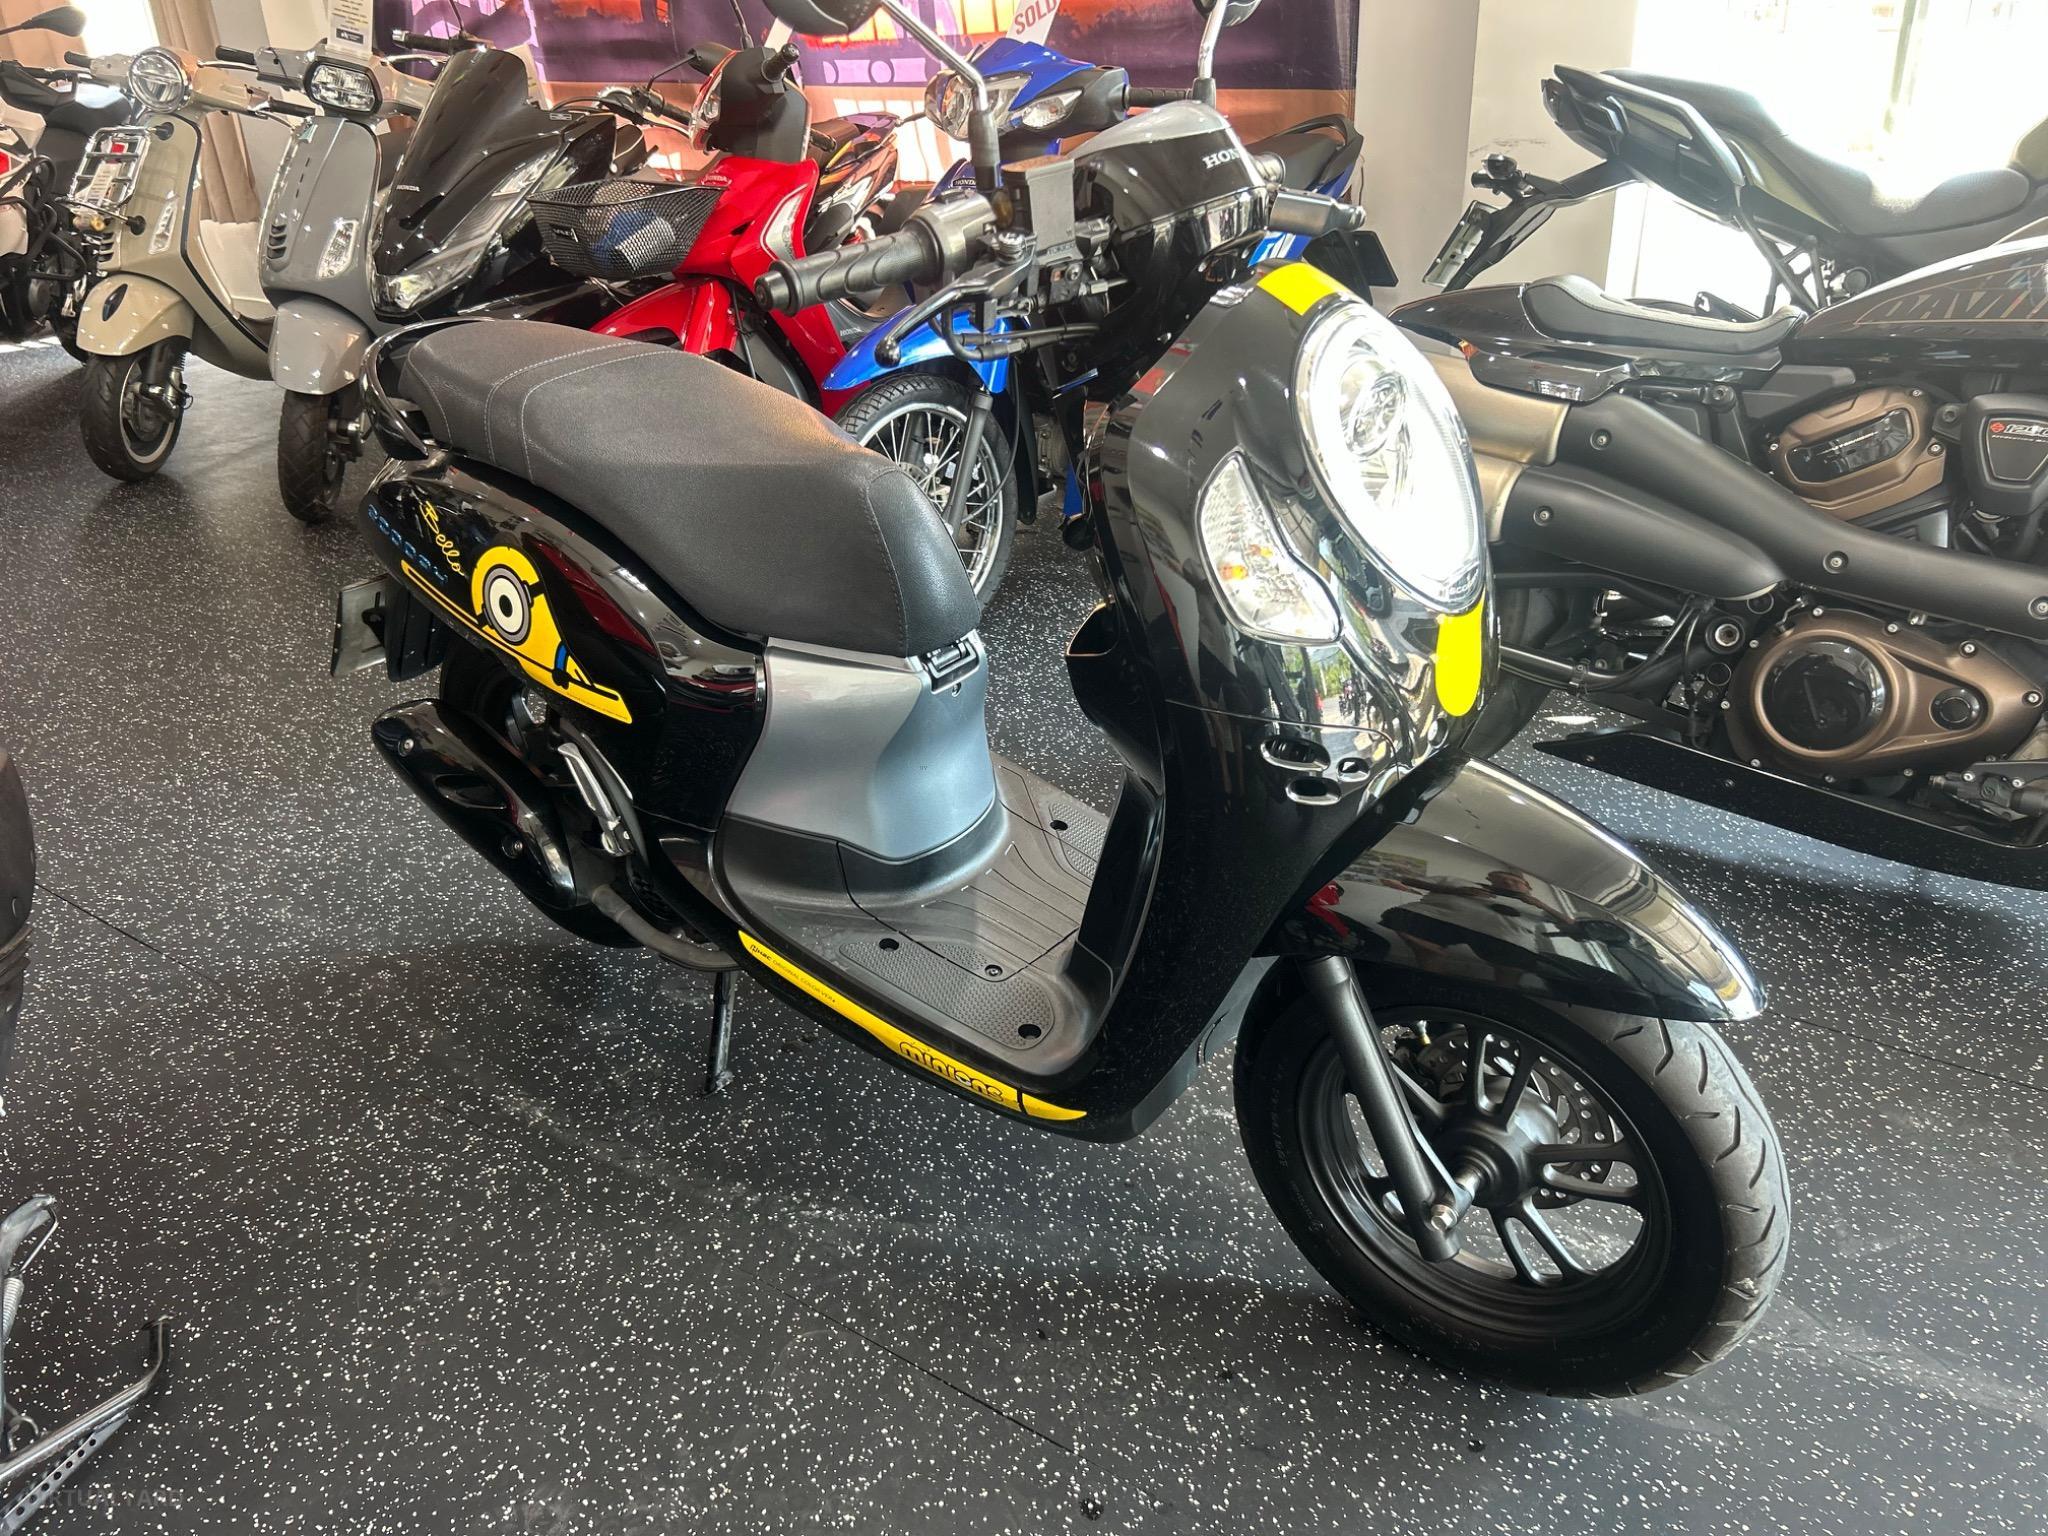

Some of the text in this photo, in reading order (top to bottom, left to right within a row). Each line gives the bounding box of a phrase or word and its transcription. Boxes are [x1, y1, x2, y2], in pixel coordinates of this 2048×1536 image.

[1014, 0, 1057, 35] SOLD
[419, 501, 465, 577] Bello
[899, 1041, 1004, 1102] minions
